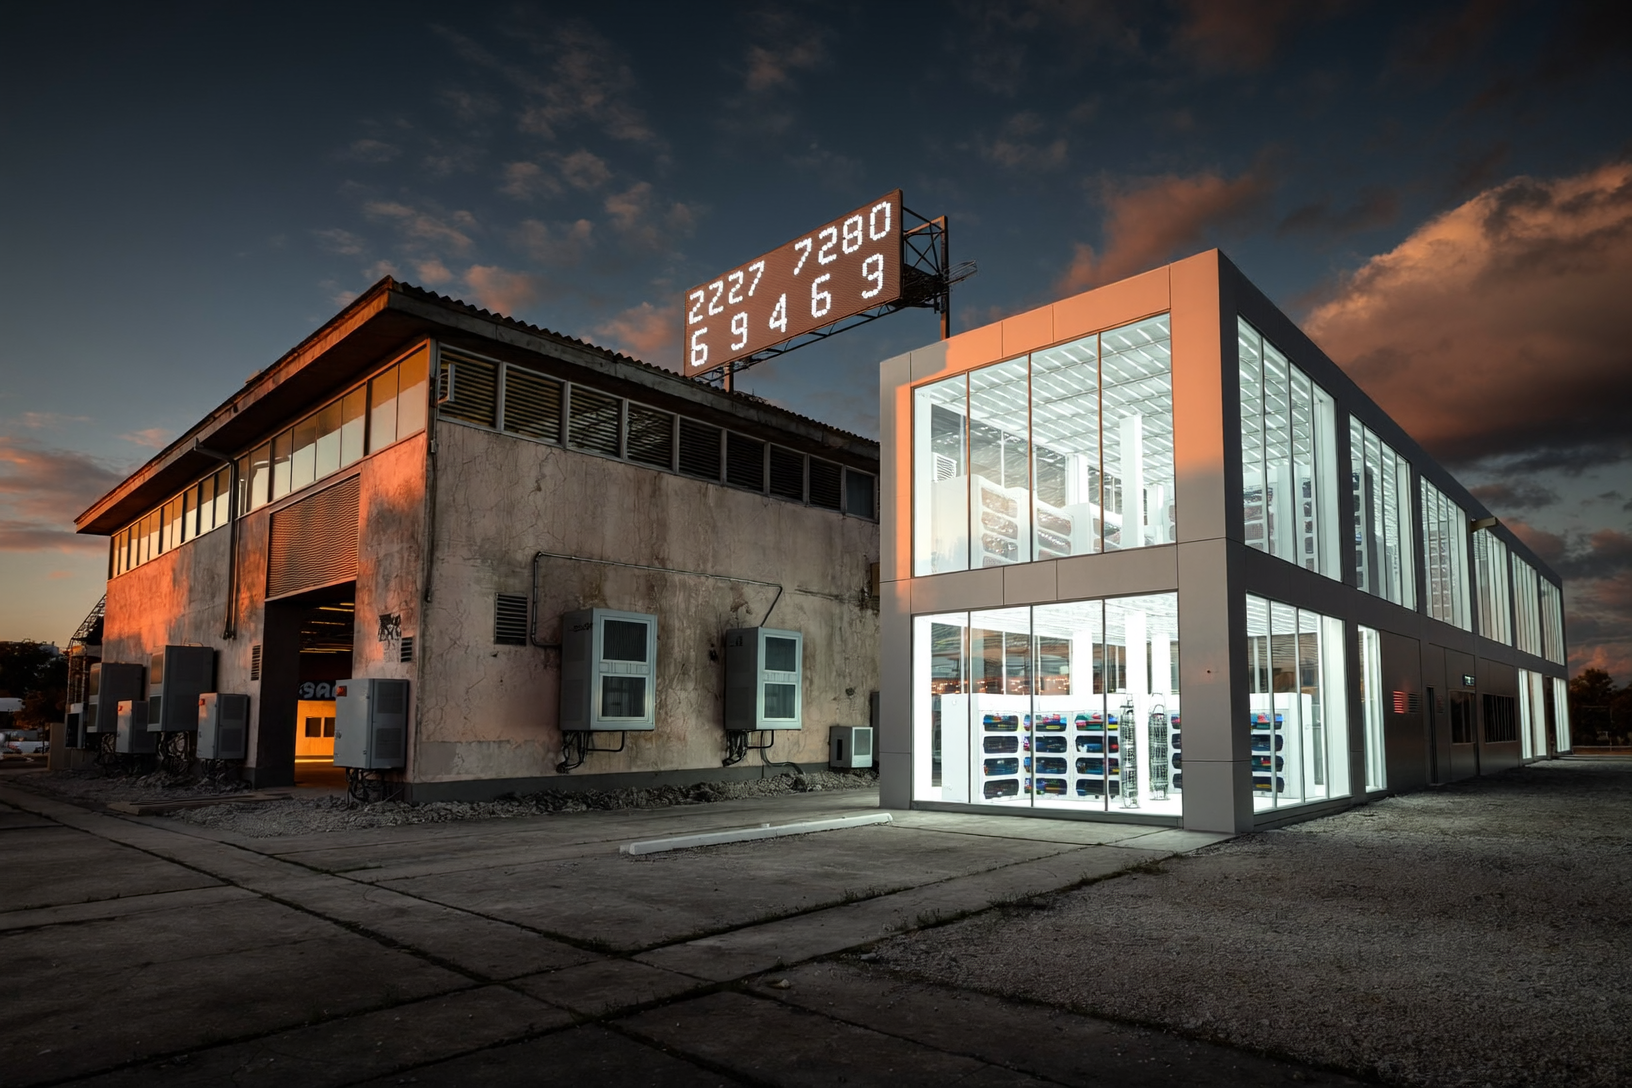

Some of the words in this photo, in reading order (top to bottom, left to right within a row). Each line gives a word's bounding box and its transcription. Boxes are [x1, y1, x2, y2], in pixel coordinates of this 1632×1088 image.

[688, 260, 765, 325] 2227
[793, 201, 892, 276] 7280
[690, 327, 709, 367] 6
[730, 311, 749, 351] 9
[768, 292, 788, 333] 4
[810, 272, 832, 319] 6
[861, 252, 884, 299] 9
